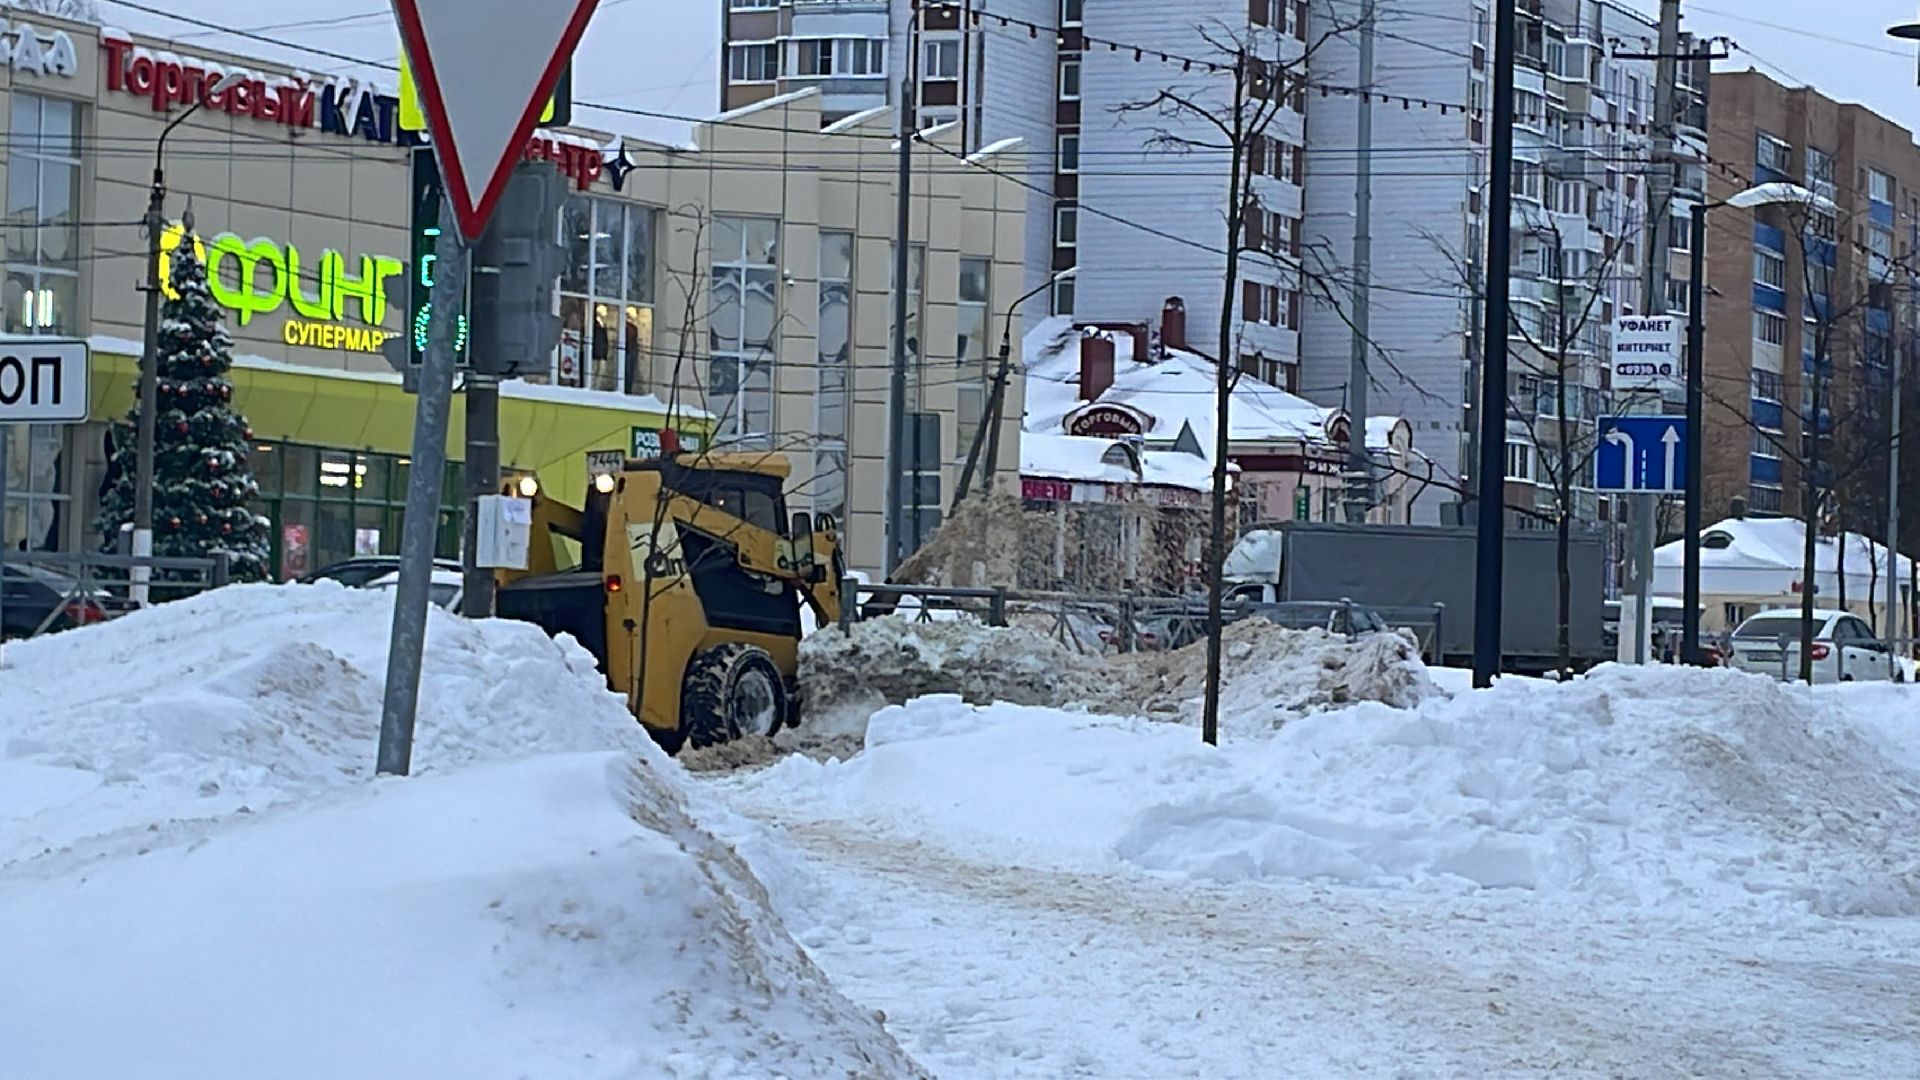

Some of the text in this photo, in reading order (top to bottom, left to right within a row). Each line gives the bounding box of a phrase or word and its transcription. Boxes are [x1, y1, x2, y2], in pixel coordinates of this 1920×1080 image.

[103, 36, 316, 128] Торговый
[320, 80, 431, 146] КАТ
[284, 319, 404, 353] СУПЕРМАР
[1619, 320, 1672, 332] УФАНЕТ
[0, 356, 62, 405] ОП
